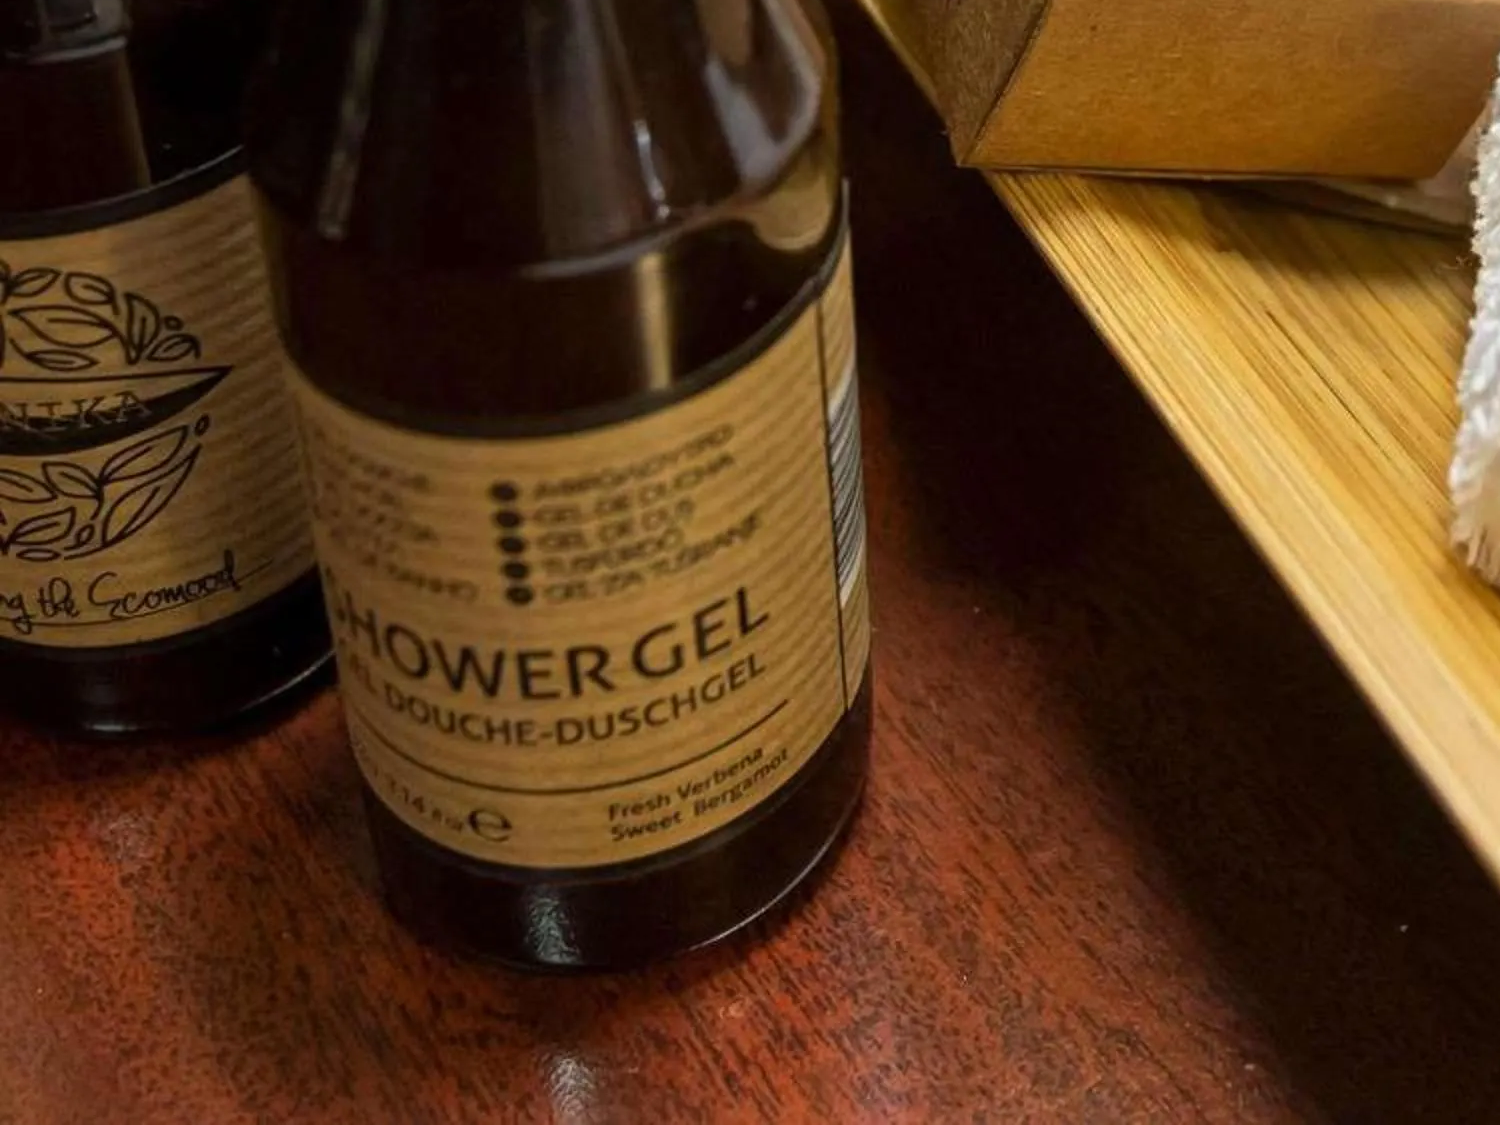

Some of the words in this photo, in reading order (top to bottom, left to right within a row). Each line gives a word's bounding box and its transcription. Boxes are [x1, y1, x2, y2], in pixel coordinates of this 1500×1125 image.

[632, 586, 770, 678] GEL
[383, 651, 767, 747] DOUCHE-DUSCHGEL
[608, 793, 671, 822] Fresh
[677, 746, 764, 800] Verbena
[610, 811, 682, 842] Sweet
[693, 747, 790, 817] Bergamot
